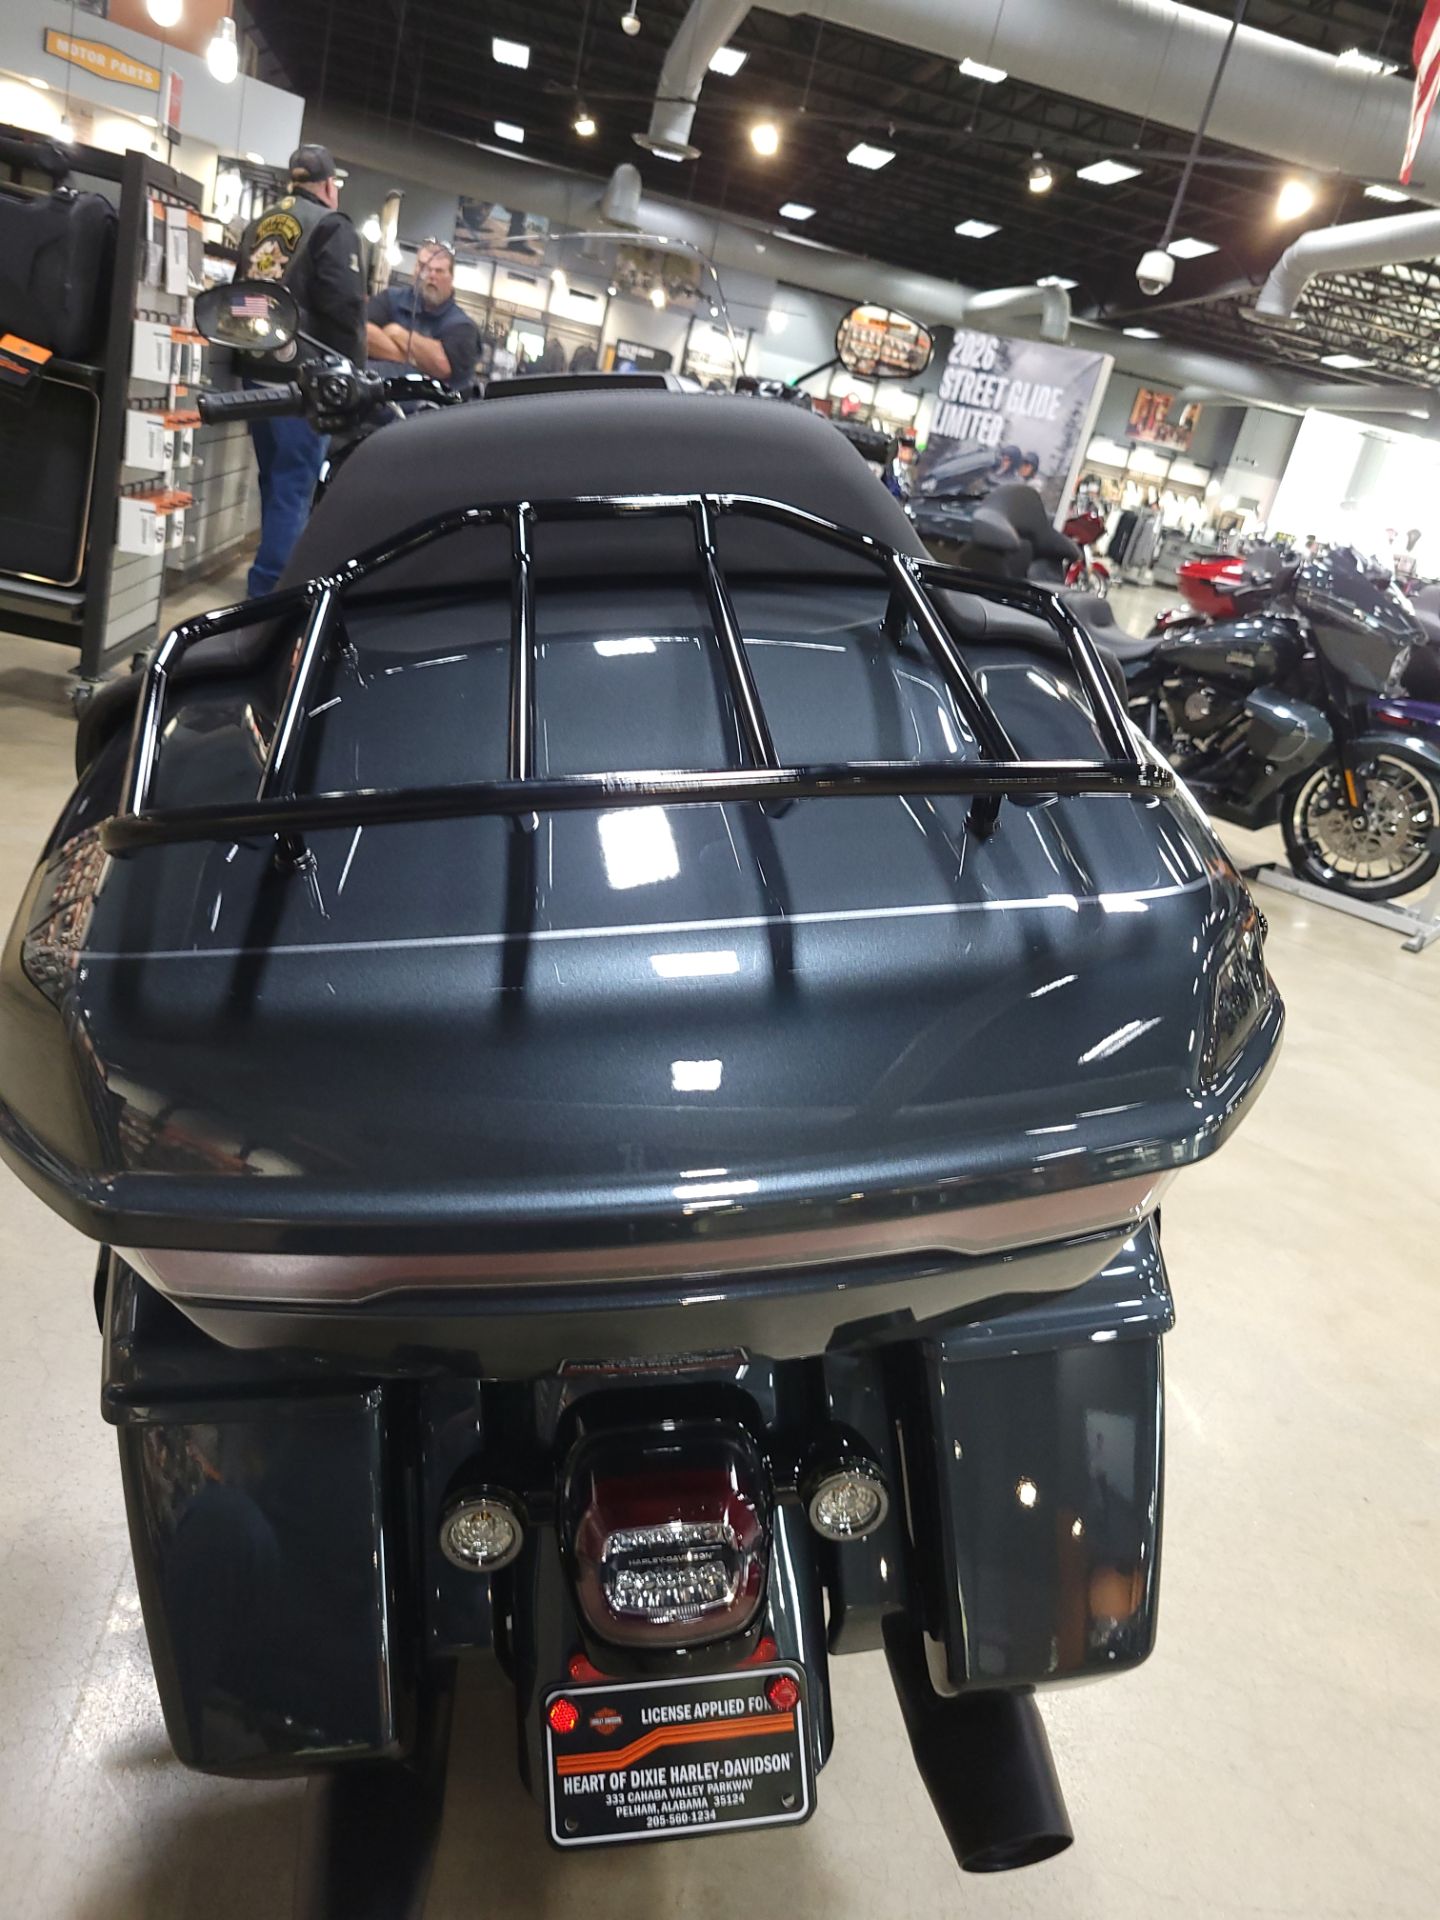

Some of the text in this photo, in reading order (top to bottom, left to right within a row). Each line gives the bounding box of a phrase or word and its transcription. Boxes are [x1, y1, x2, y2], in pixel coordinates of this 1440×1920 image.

[56, 38, 154, 84] MOTOR PARTS
[948, 330, 999, 371] 2026
[939, 365, 1064, 421] STREET GLIDE
[931, 401, 1004, 447] LIMITED
[628, 1551, 714, 1566] HARLEY-DAVISON
[641, 1703, 692, 1725] LICENSE
[693, 1698, 745, 1720] APPLIED
[563, 1752, 791, 1796] HEART OF DIXIE HARLEY-DAVIDSON
[605, 1778, 753, 1807] 333 CAHABA VALLEY PARKWAY
[616, 1792, 745, 1818] PELHAM, ALABAMA 35124
